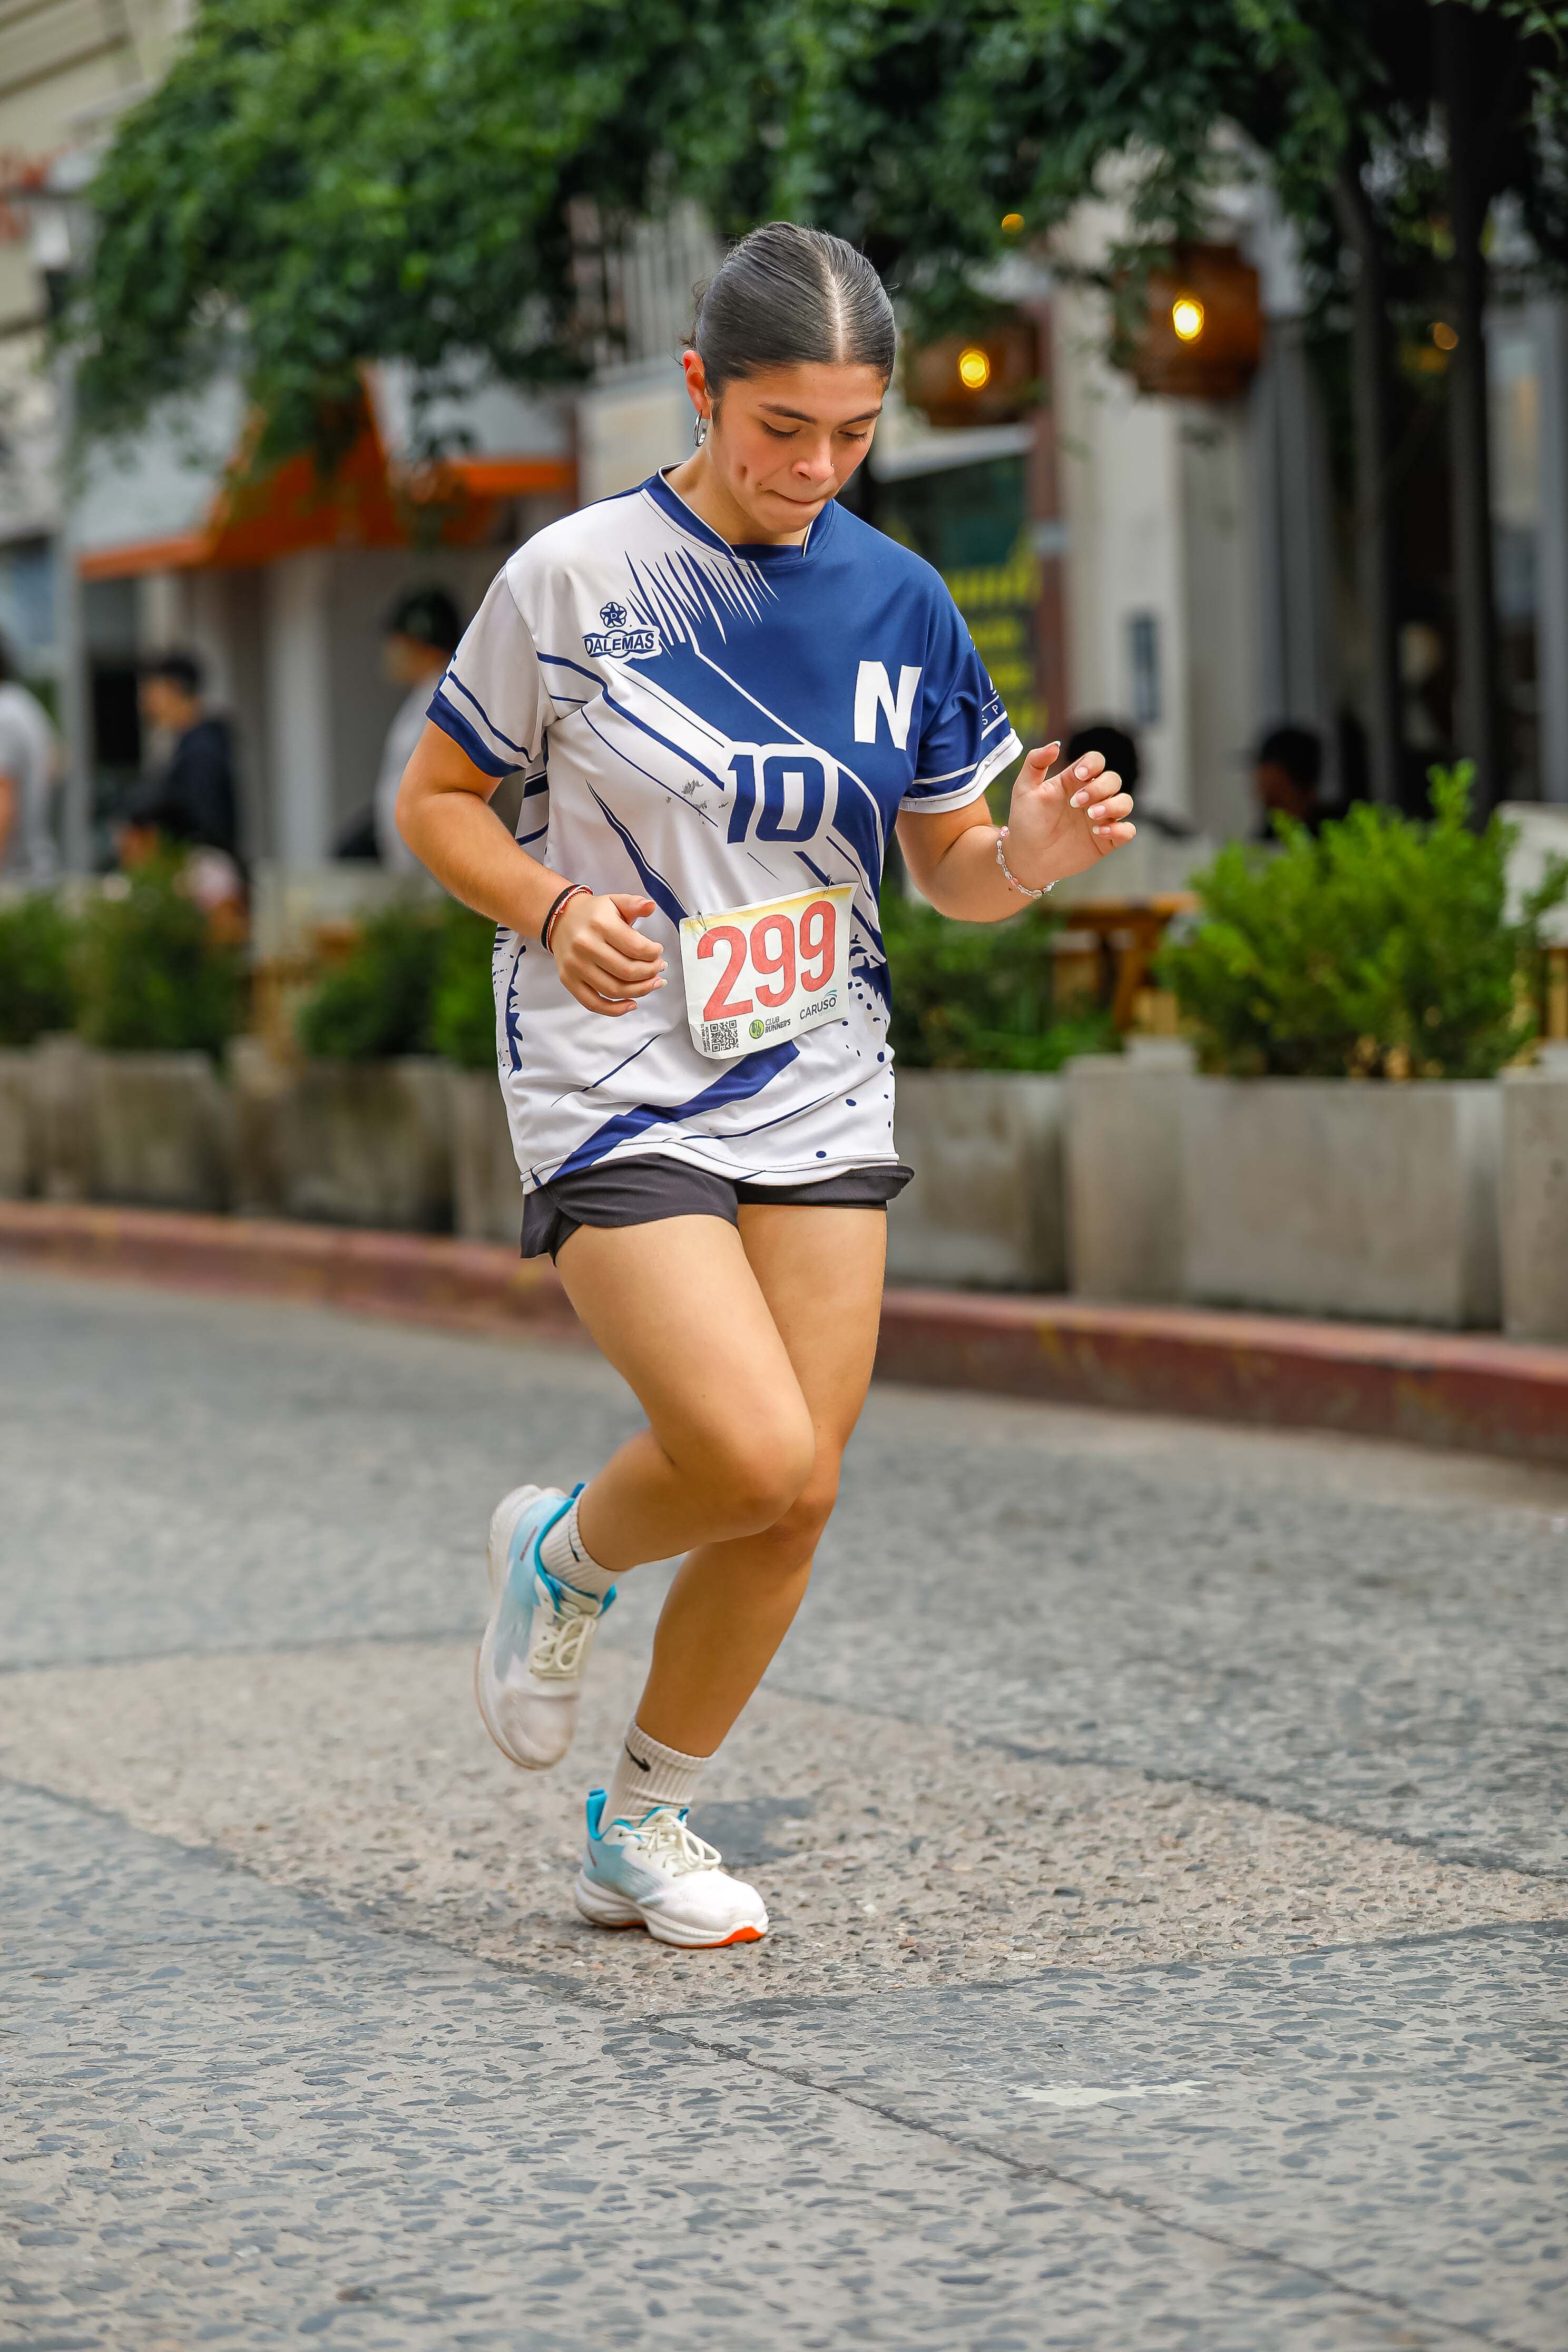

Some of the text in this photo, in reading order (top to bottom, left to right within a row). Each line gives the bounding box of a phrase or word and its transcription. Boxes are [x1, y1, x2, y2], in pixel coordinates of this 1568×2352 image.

[584, 632, 654, 655] DALEMAS
[854, 660, 923, 751] N
[727, 753, 825, 844] 10
[697, 900, 836, 1022] 299
[800, 997, 836, 1020] CARUSO
[765, 1016, 780, 1026] CLUB
[765, 1018, 791, 1033] RUNNER'S
